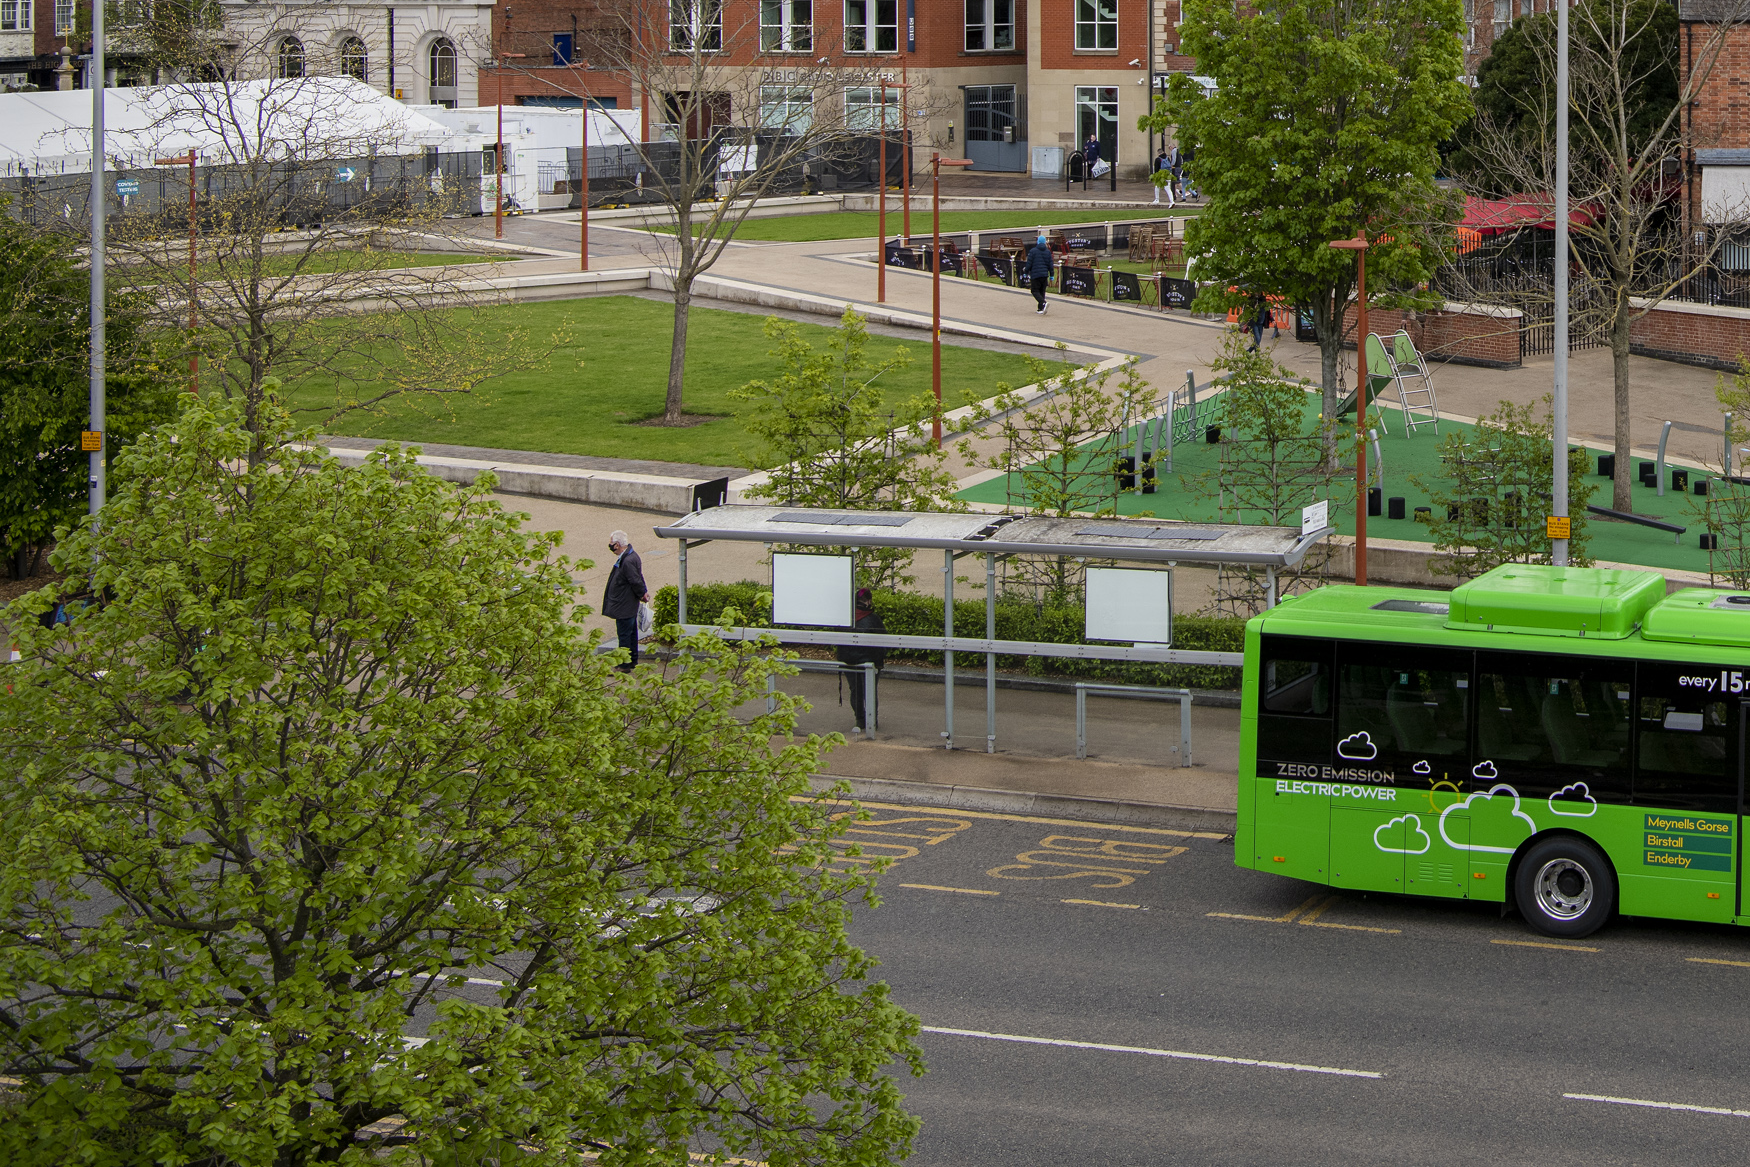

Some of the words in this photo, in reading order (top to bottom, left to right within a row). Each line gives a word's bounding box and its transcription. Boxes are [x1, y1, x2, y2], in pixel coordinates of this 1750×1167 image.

[26, 61, 42, 70] THE
[45, 60, 61, 70] HIG
[763, 71, 796, 82] BBC
[800, 71, 834, 82] RADIO
[837, 72, 895, 82] LEICESTER
[1678, 675, 1717, 692] every
[1721, 670, 1743, 693] 15
[1277, 763, 1318, 778] ZERO
[1322, 766, 1395, 784] EMISSION
[1276, 780, 1340, 797] ELECTRIC
[1342, 786, 1396, 801] POWER
[1647, 816, 1695, 831] Meynells
[1696, 819, 1729, 833] Gorse
[1647, 834, 1684, 848] Birstall
[986, 834, 1190, 889] BUS
[1647, 852, 1692, 869] Enderby
